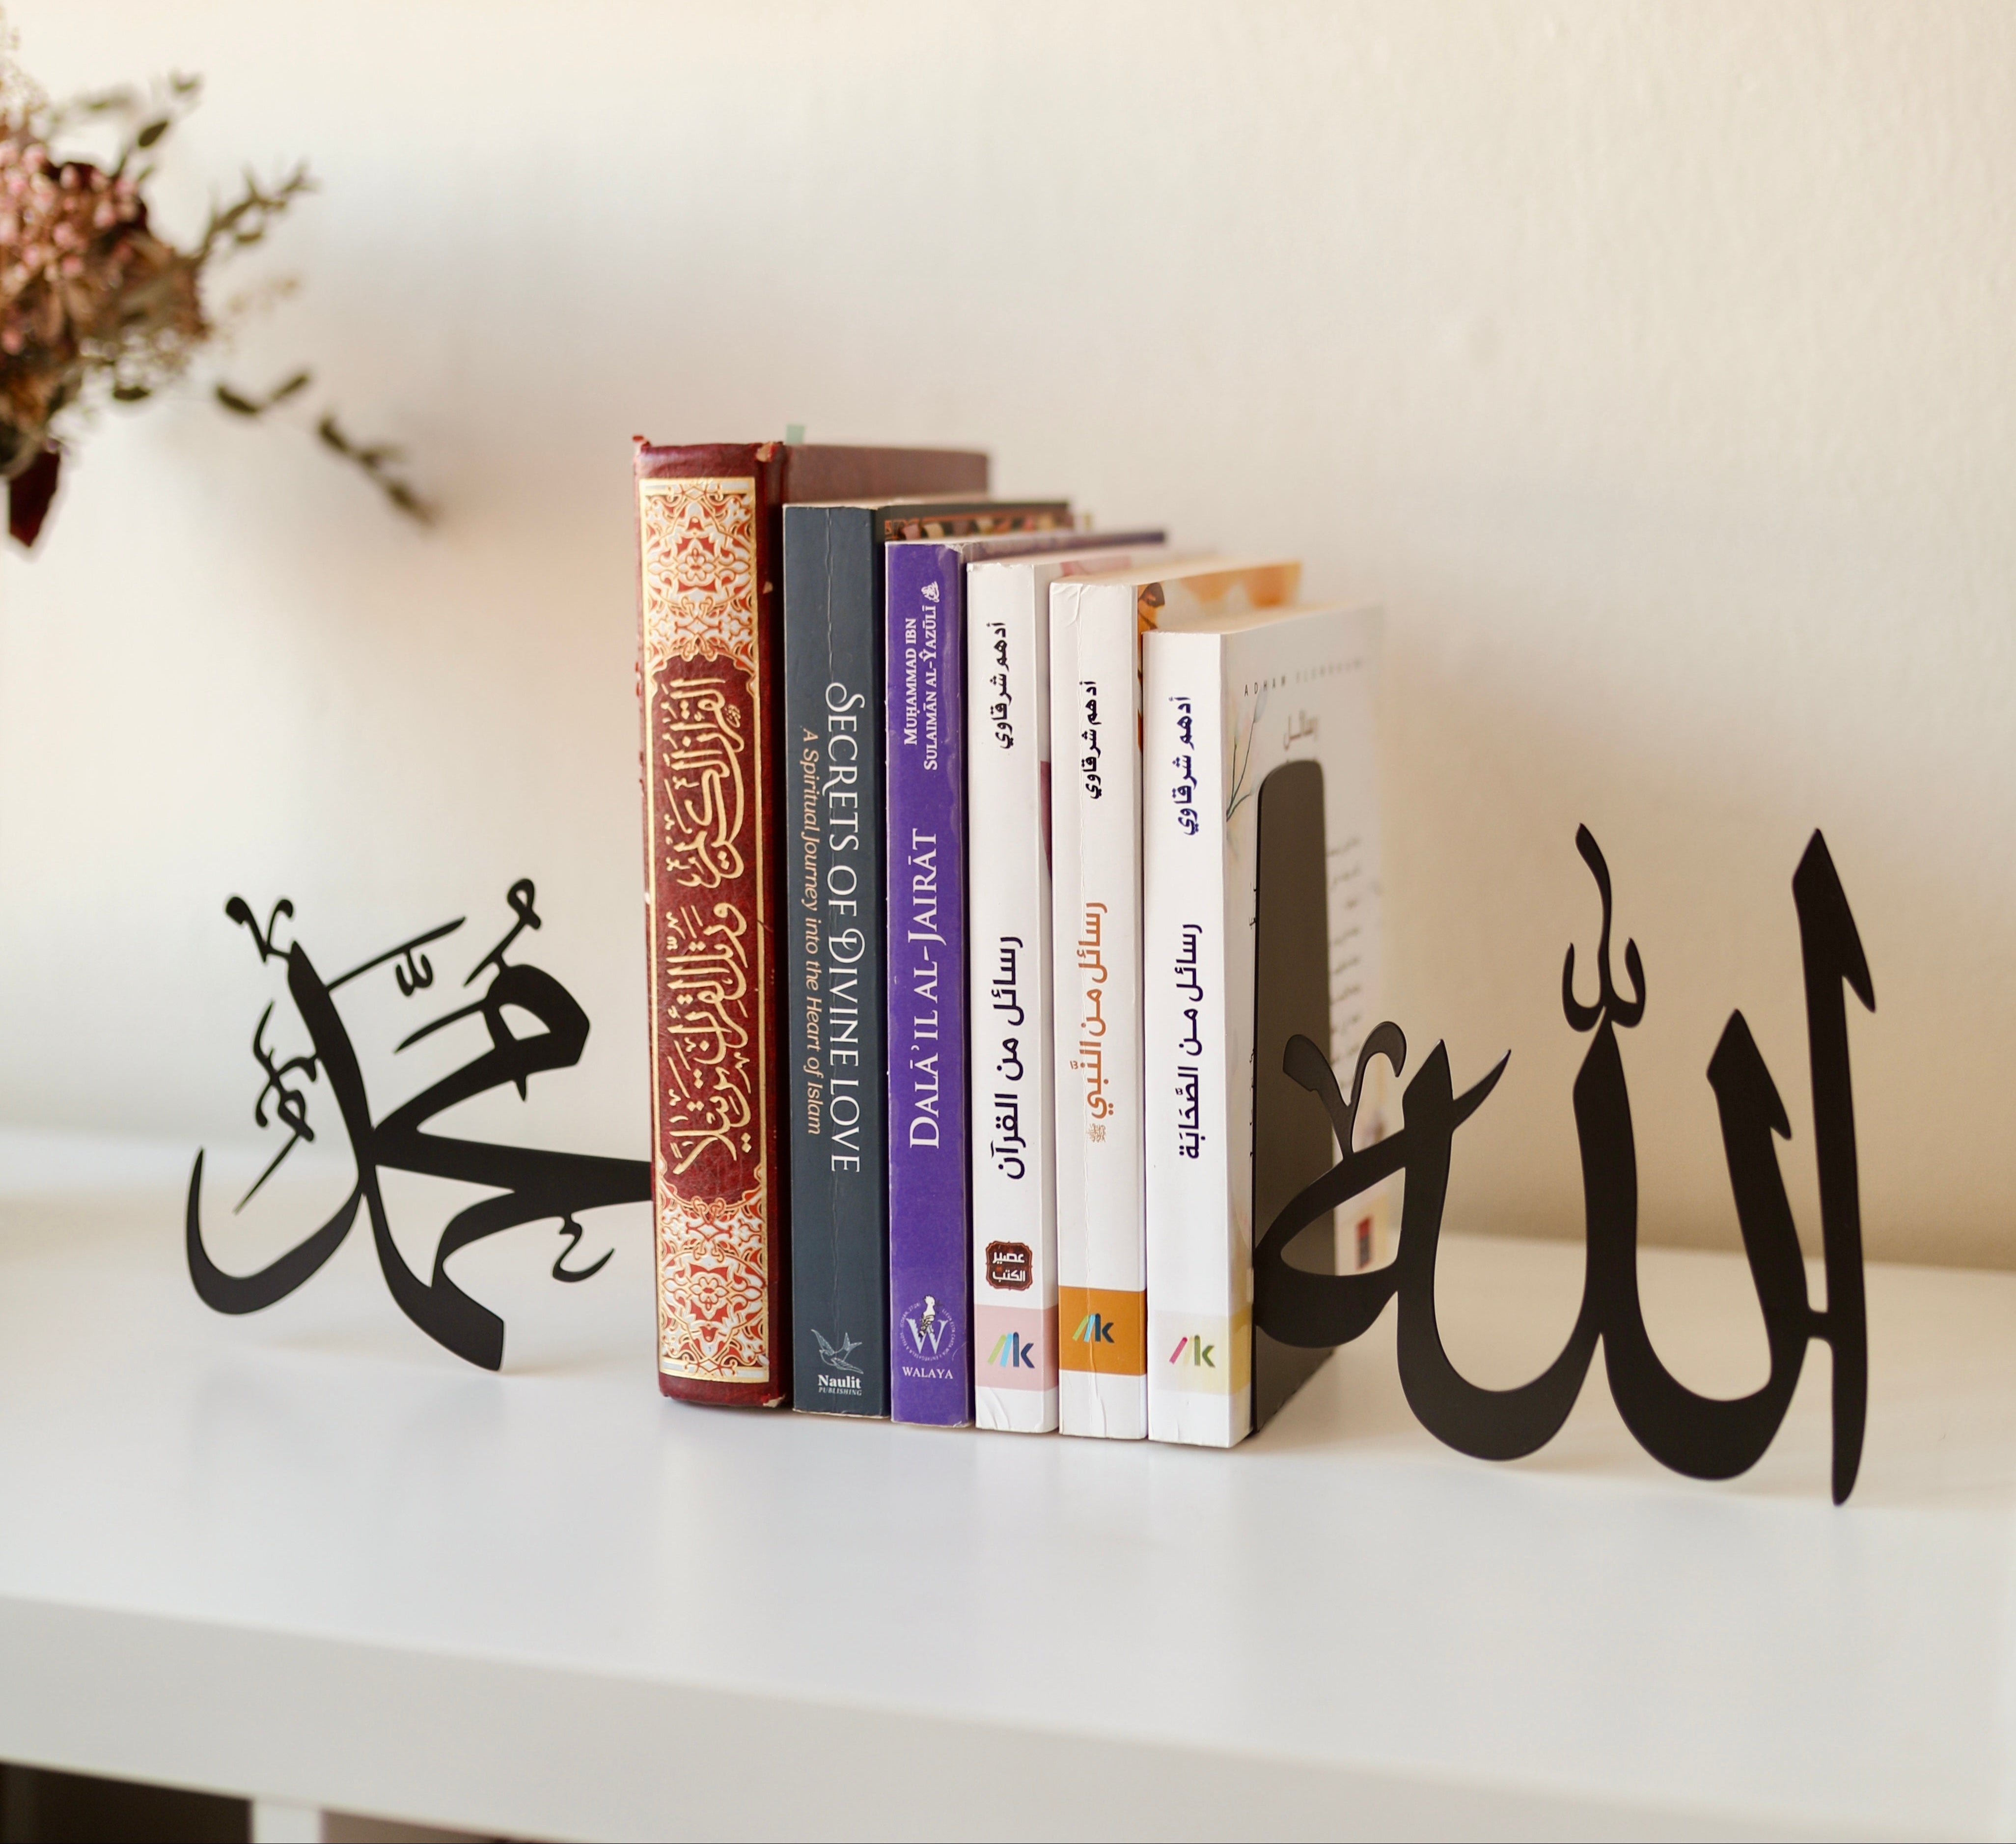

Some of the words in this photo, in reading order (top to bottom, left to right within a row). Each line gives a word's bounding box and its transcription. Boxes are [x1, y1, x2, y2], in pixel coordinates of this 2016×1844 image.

[905, 618, 917, 644] IBN
[986, 622, 1009, 672] أدهم
[989, 673, 1014, 749] شرقاوي
[1079, 681, 1102, 725] أدهم
[1168, 697, 1194, 751] أدهم
[802, 728, 820, 742] A
[800, 748, 820, 830] Spiritual
[823, 682, 865, 851] SECRETS
[1081, 728, 1102, 799] شرقاوي
[1171, 755, 1199, 836] شرقاوي
[801, 833, 821, 910] Journey
[827, 865, 857, 917] OF
[804, 917, 822, 952] into
[1077, 902, 1108, 984] رسائل
[805, 961, 822, 990] the
[991, 936, 1024, 1026] رسائل
[1174, 923, 1204, 1002] رسائل
[828, 928, 865, 1066] DIVINE
[1081, 988, 1106, 1036] من
[806, 997, 824, 1051] Heart
[1179, 1008, 1202, 1056] من
[802, 1057, 824, 1078] of
[996, 1038, 1023, 1081] من
[806, 1082, 824, 1134] Islam
[829, 1078, 860, 1173] LOVE
[990, 1093, 1026, 1180] القرآن
[993, 1251, 1025, 1264] عصير
[993, 1269, 1026, 1283] الكتب
[818, 1374, 861, 1389] Naulit
[818, 1386, 862, 1396] PUBLISHING
[902, 1366, 954, 1379] WALAYA
